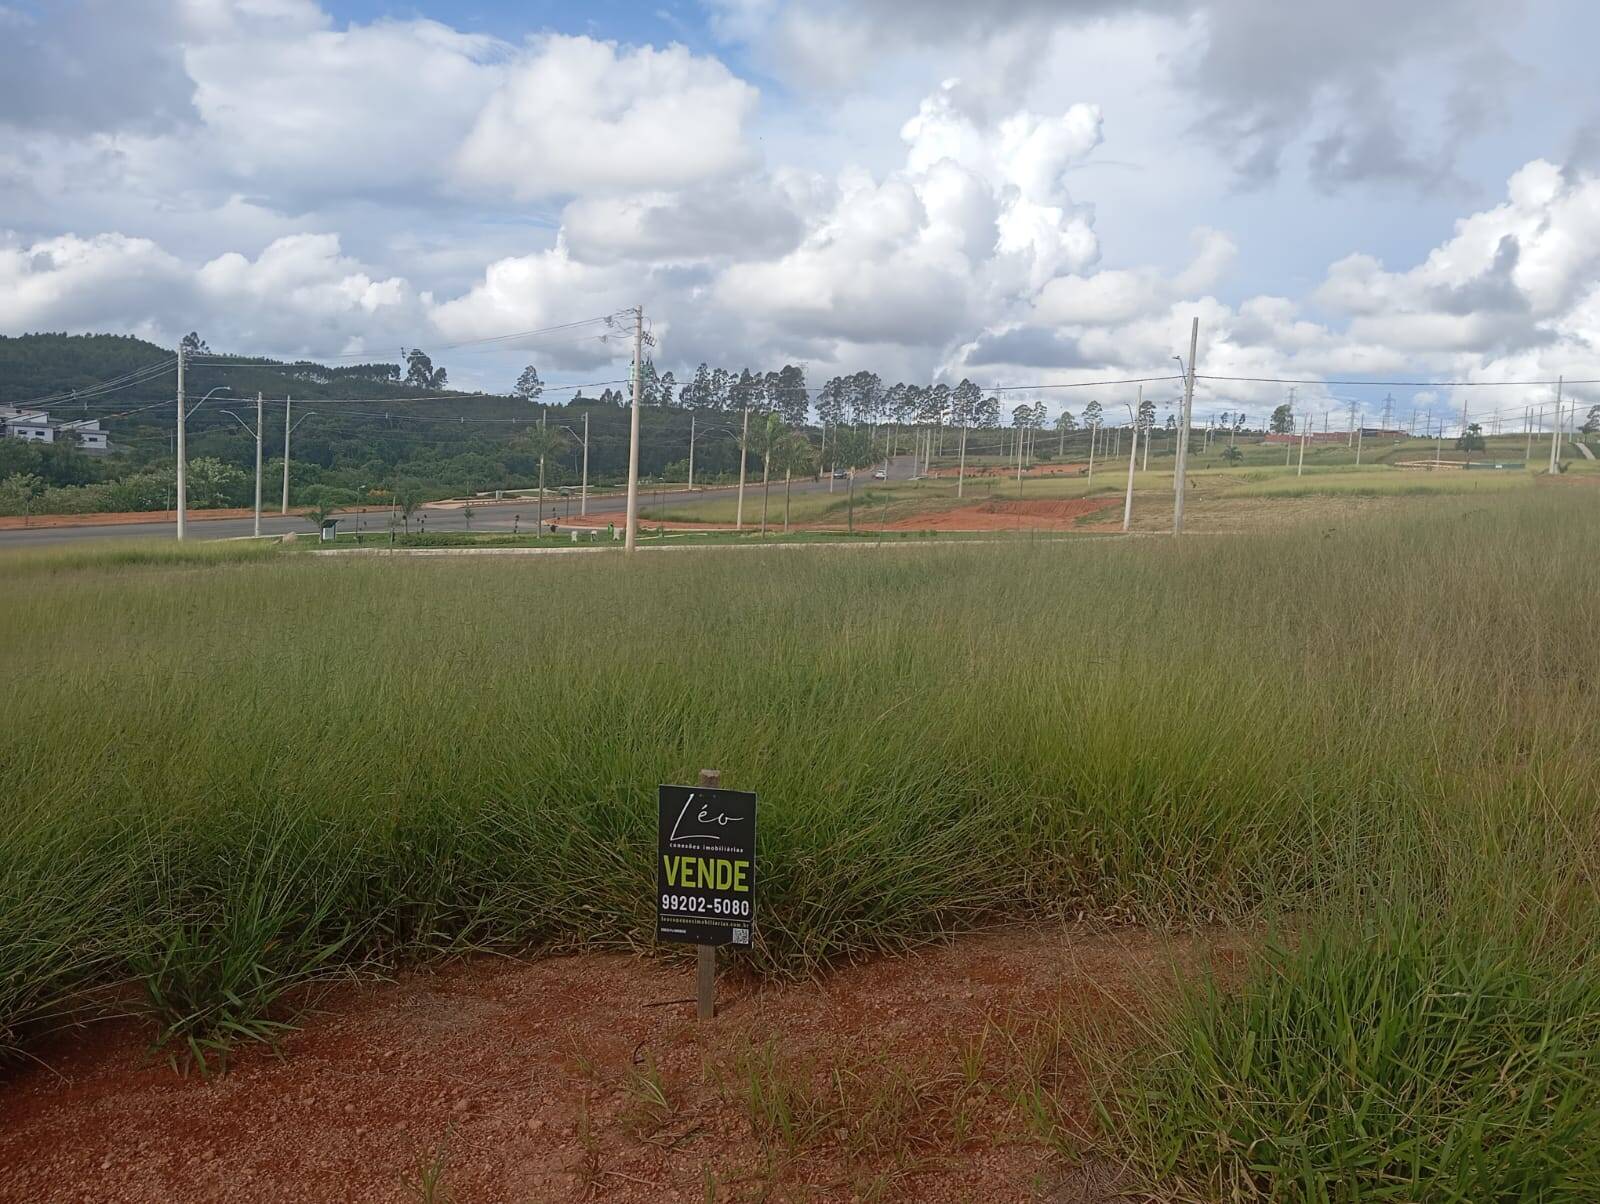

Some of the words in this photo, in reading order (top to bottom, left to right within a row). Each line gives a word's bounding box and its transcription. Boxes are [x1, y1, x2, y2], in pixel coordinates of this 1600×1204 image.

[670, 793, 744, 841] Léo
[663, 855, 750, 892] VENDE
[662, 894, 750, 916] 99202-5080
